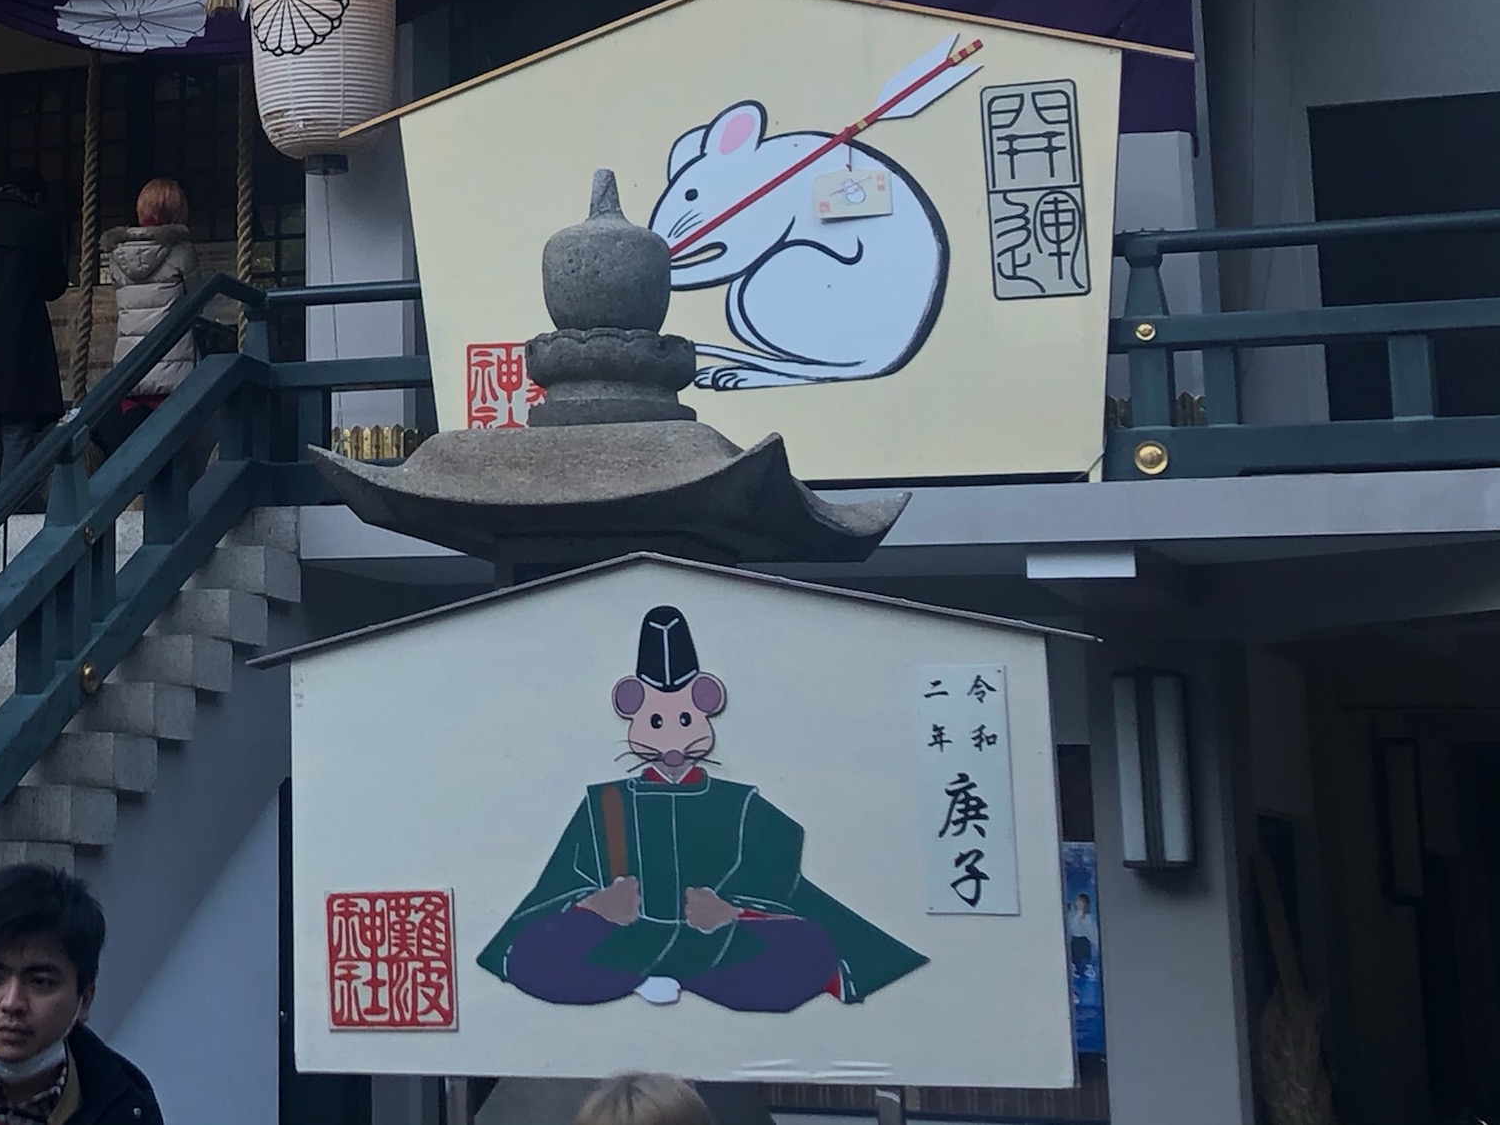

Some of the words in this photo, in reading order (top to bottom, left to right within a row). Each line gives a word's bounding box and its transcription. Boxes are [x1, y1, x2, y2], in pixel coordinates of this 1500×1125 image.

[924, 680, 953, 753] 二年
[967, 675, 998, 751] 令和
[938, 773, 991, 908] 庚子
